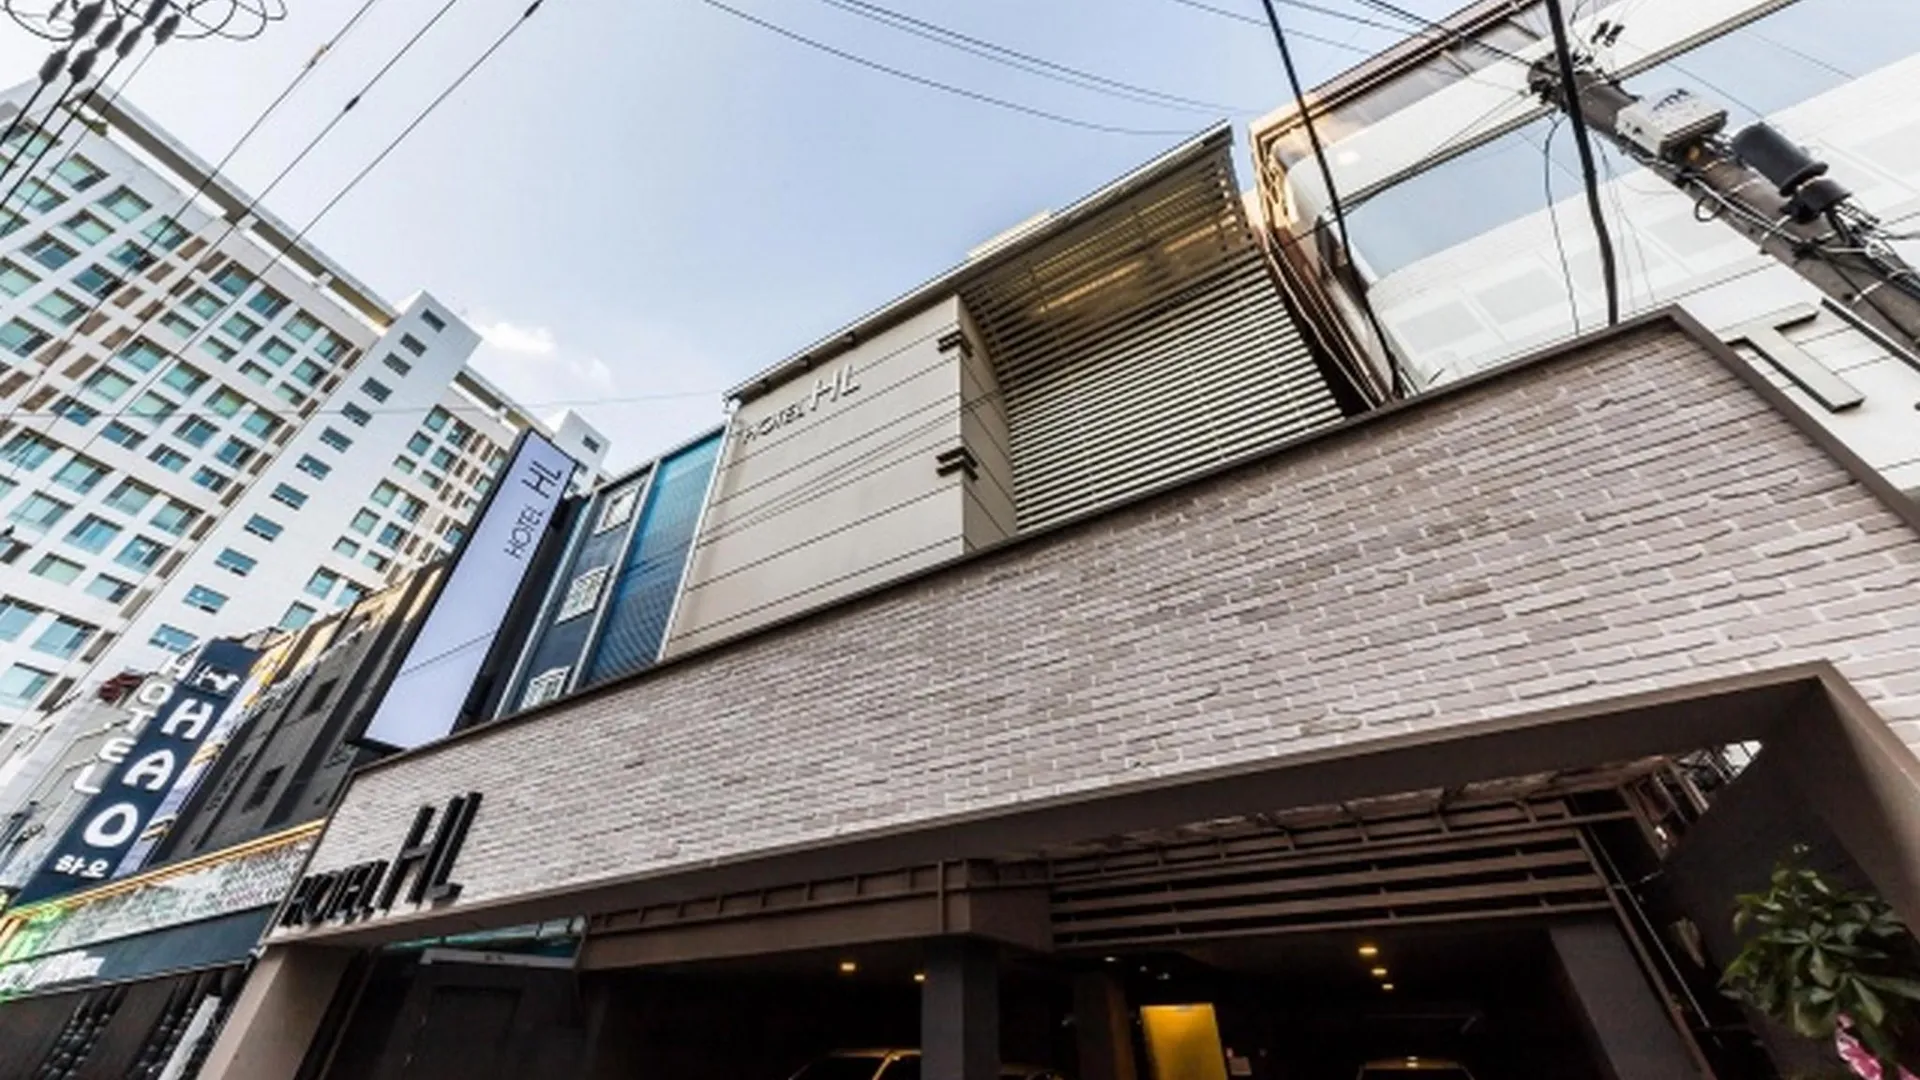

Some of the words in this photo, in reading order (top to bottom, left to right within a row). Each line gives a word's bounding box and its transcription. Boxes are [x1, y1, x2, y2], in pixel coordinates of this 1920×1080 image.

[742, 402, 806, 445] HOTEL
[808, 363, 861, 412] HL
[521, 460, 562, 499] HL
[504, 503, 545, 560] HOTEL
[73, 651, 202, 795] HOTEL
[83, 698, 215, 848] HAO
[54, 854, 109, 878] 하오
[279, 859, 391, 926] HOTEL
[373, 791, 484, 913] HL
